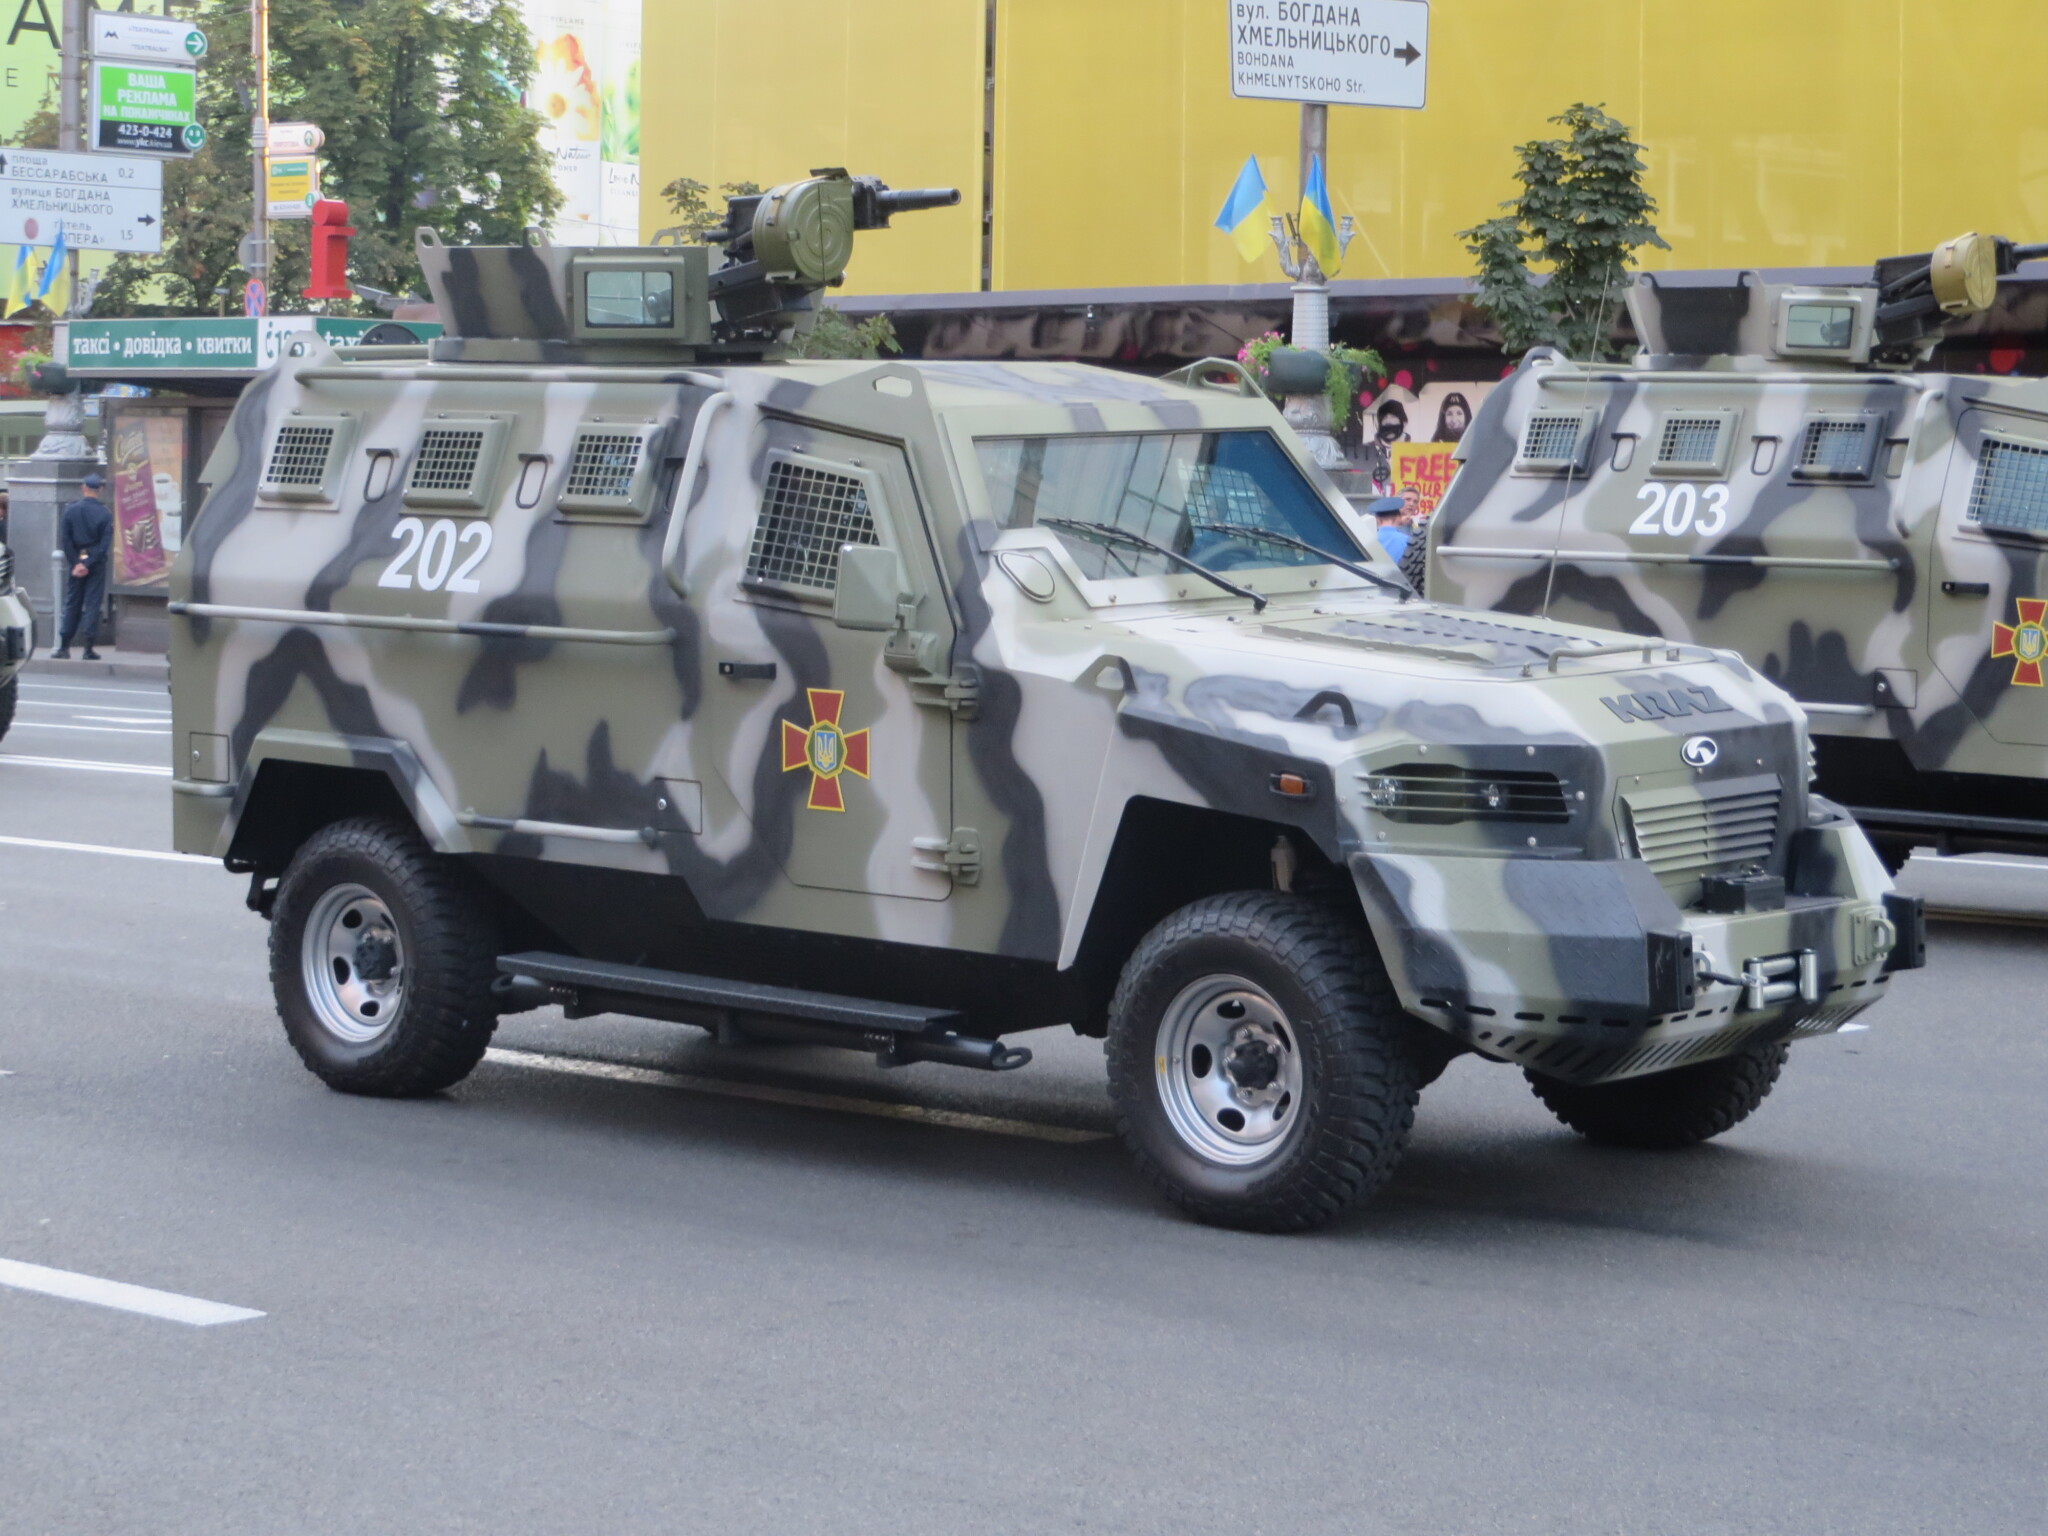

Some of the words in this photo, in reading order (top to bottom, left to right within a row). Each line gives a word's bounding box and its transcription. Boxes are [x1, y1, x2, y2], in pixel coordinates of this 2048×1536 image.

[1237, 4, 1270, 24] вул.
[1278, 1, 1361, 28] БОГДАНА
[1237, 24, 1391, 56] ХМЕЛЬНИЦЬКОГО
[1237, 51, 1295, 69] BOHDANA
[127, 73, 167, 90] ВАША
[1238, 72, 1341, 93] KHMELNYTSKOHO
[1346, 79, 1366, 94] Str.
[117, 88, 178, 107] РЕКЛАМА
[103, 105, 119, 118] НА
[118, 124, 173, 139] 423-0-424
[11, 155, 48, 166] площа
[12, 166, 108, 183] БЕССАРАБСЬКА
[11, 187, 51, 199] вулиця
[55, 188, 111, 201] БОГДАНА
[12, 199, 114, 215] ХМЕЛЬНИЦЬКОГО
[73, 331, 110, 355] таксі
[123, 331, 182, 358] довідка
[196, 335, 252, 355] квитки
[1629, 482, 1730, 536] 203
[378, 517, 493, 593] 202
